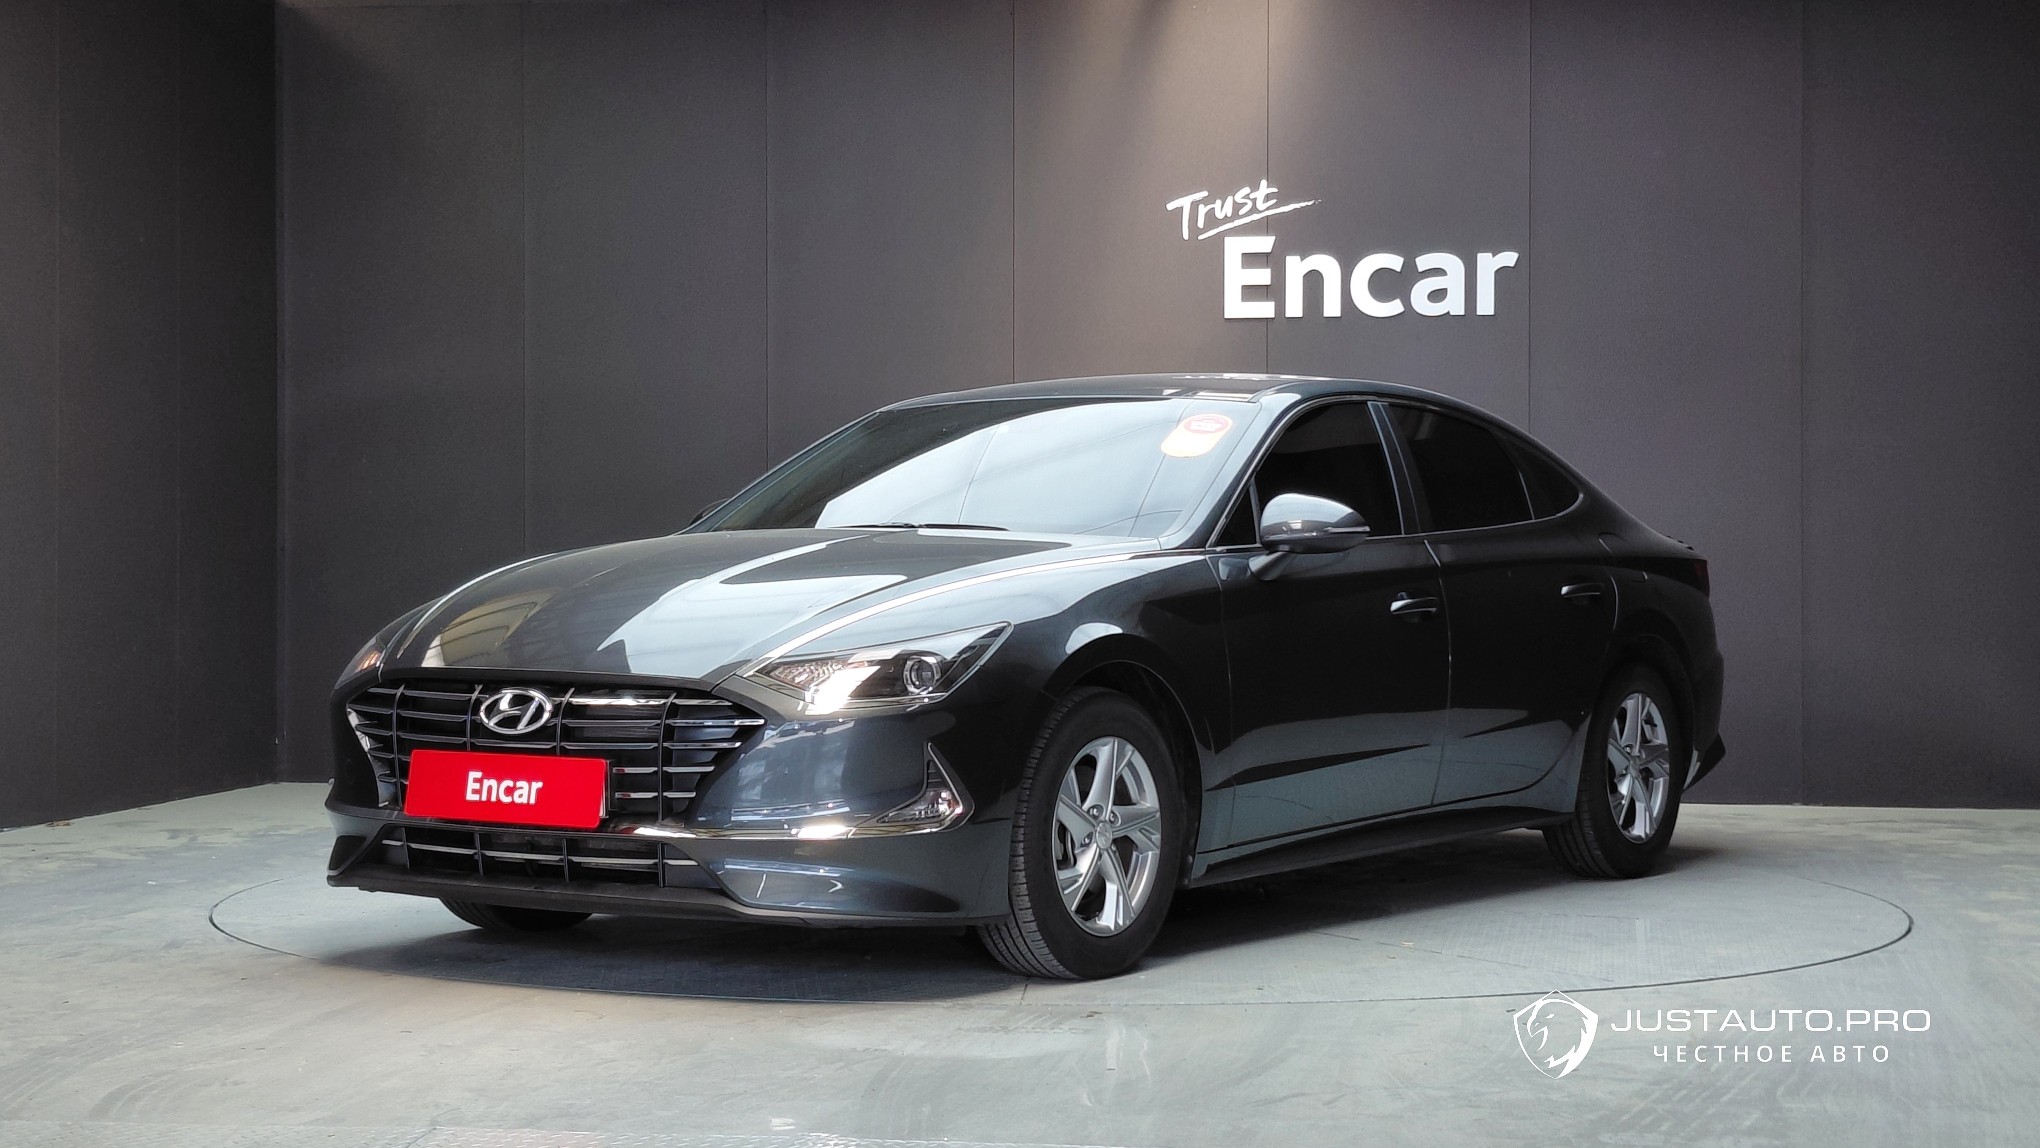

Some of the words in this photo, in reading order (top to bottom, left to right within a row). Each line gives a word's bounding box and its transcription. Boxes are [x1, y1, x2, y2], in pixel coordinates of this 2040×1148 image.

[1166, 179, 1279, 240] Trust
[1223, 235, 1519, 319] Encar
[465, 771, 543, 805] Encar
